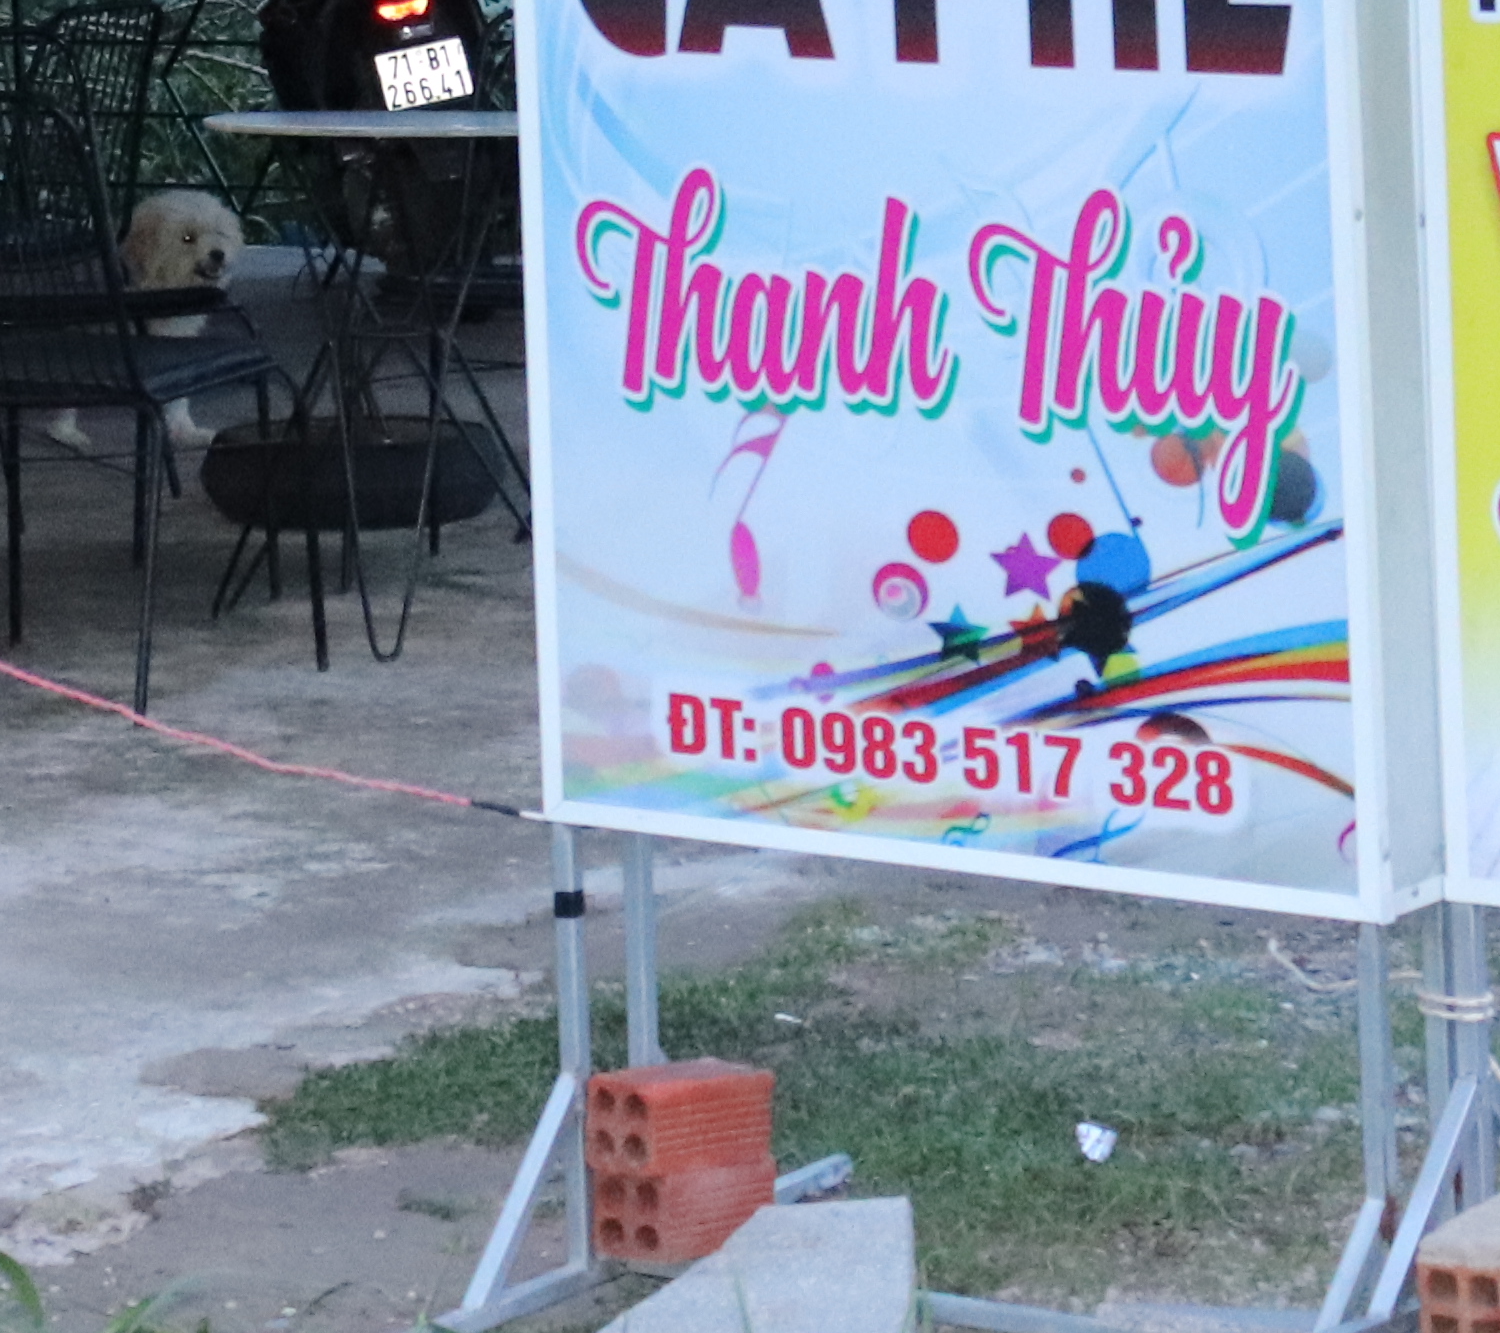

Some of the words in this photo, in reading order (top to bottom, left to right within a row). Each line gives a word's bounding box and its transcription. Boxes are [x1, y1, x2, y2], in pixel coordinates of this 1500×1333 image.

[575, 167, 958, 407] Thanh
[967, 186, 1301, 544] Thủy
[667, 692, 759, 763] ĐT:
[781, 706, 939, 785] 0983
[962, 727, 1083, 800] 517
[1108, 741, 1234, 817] 328
